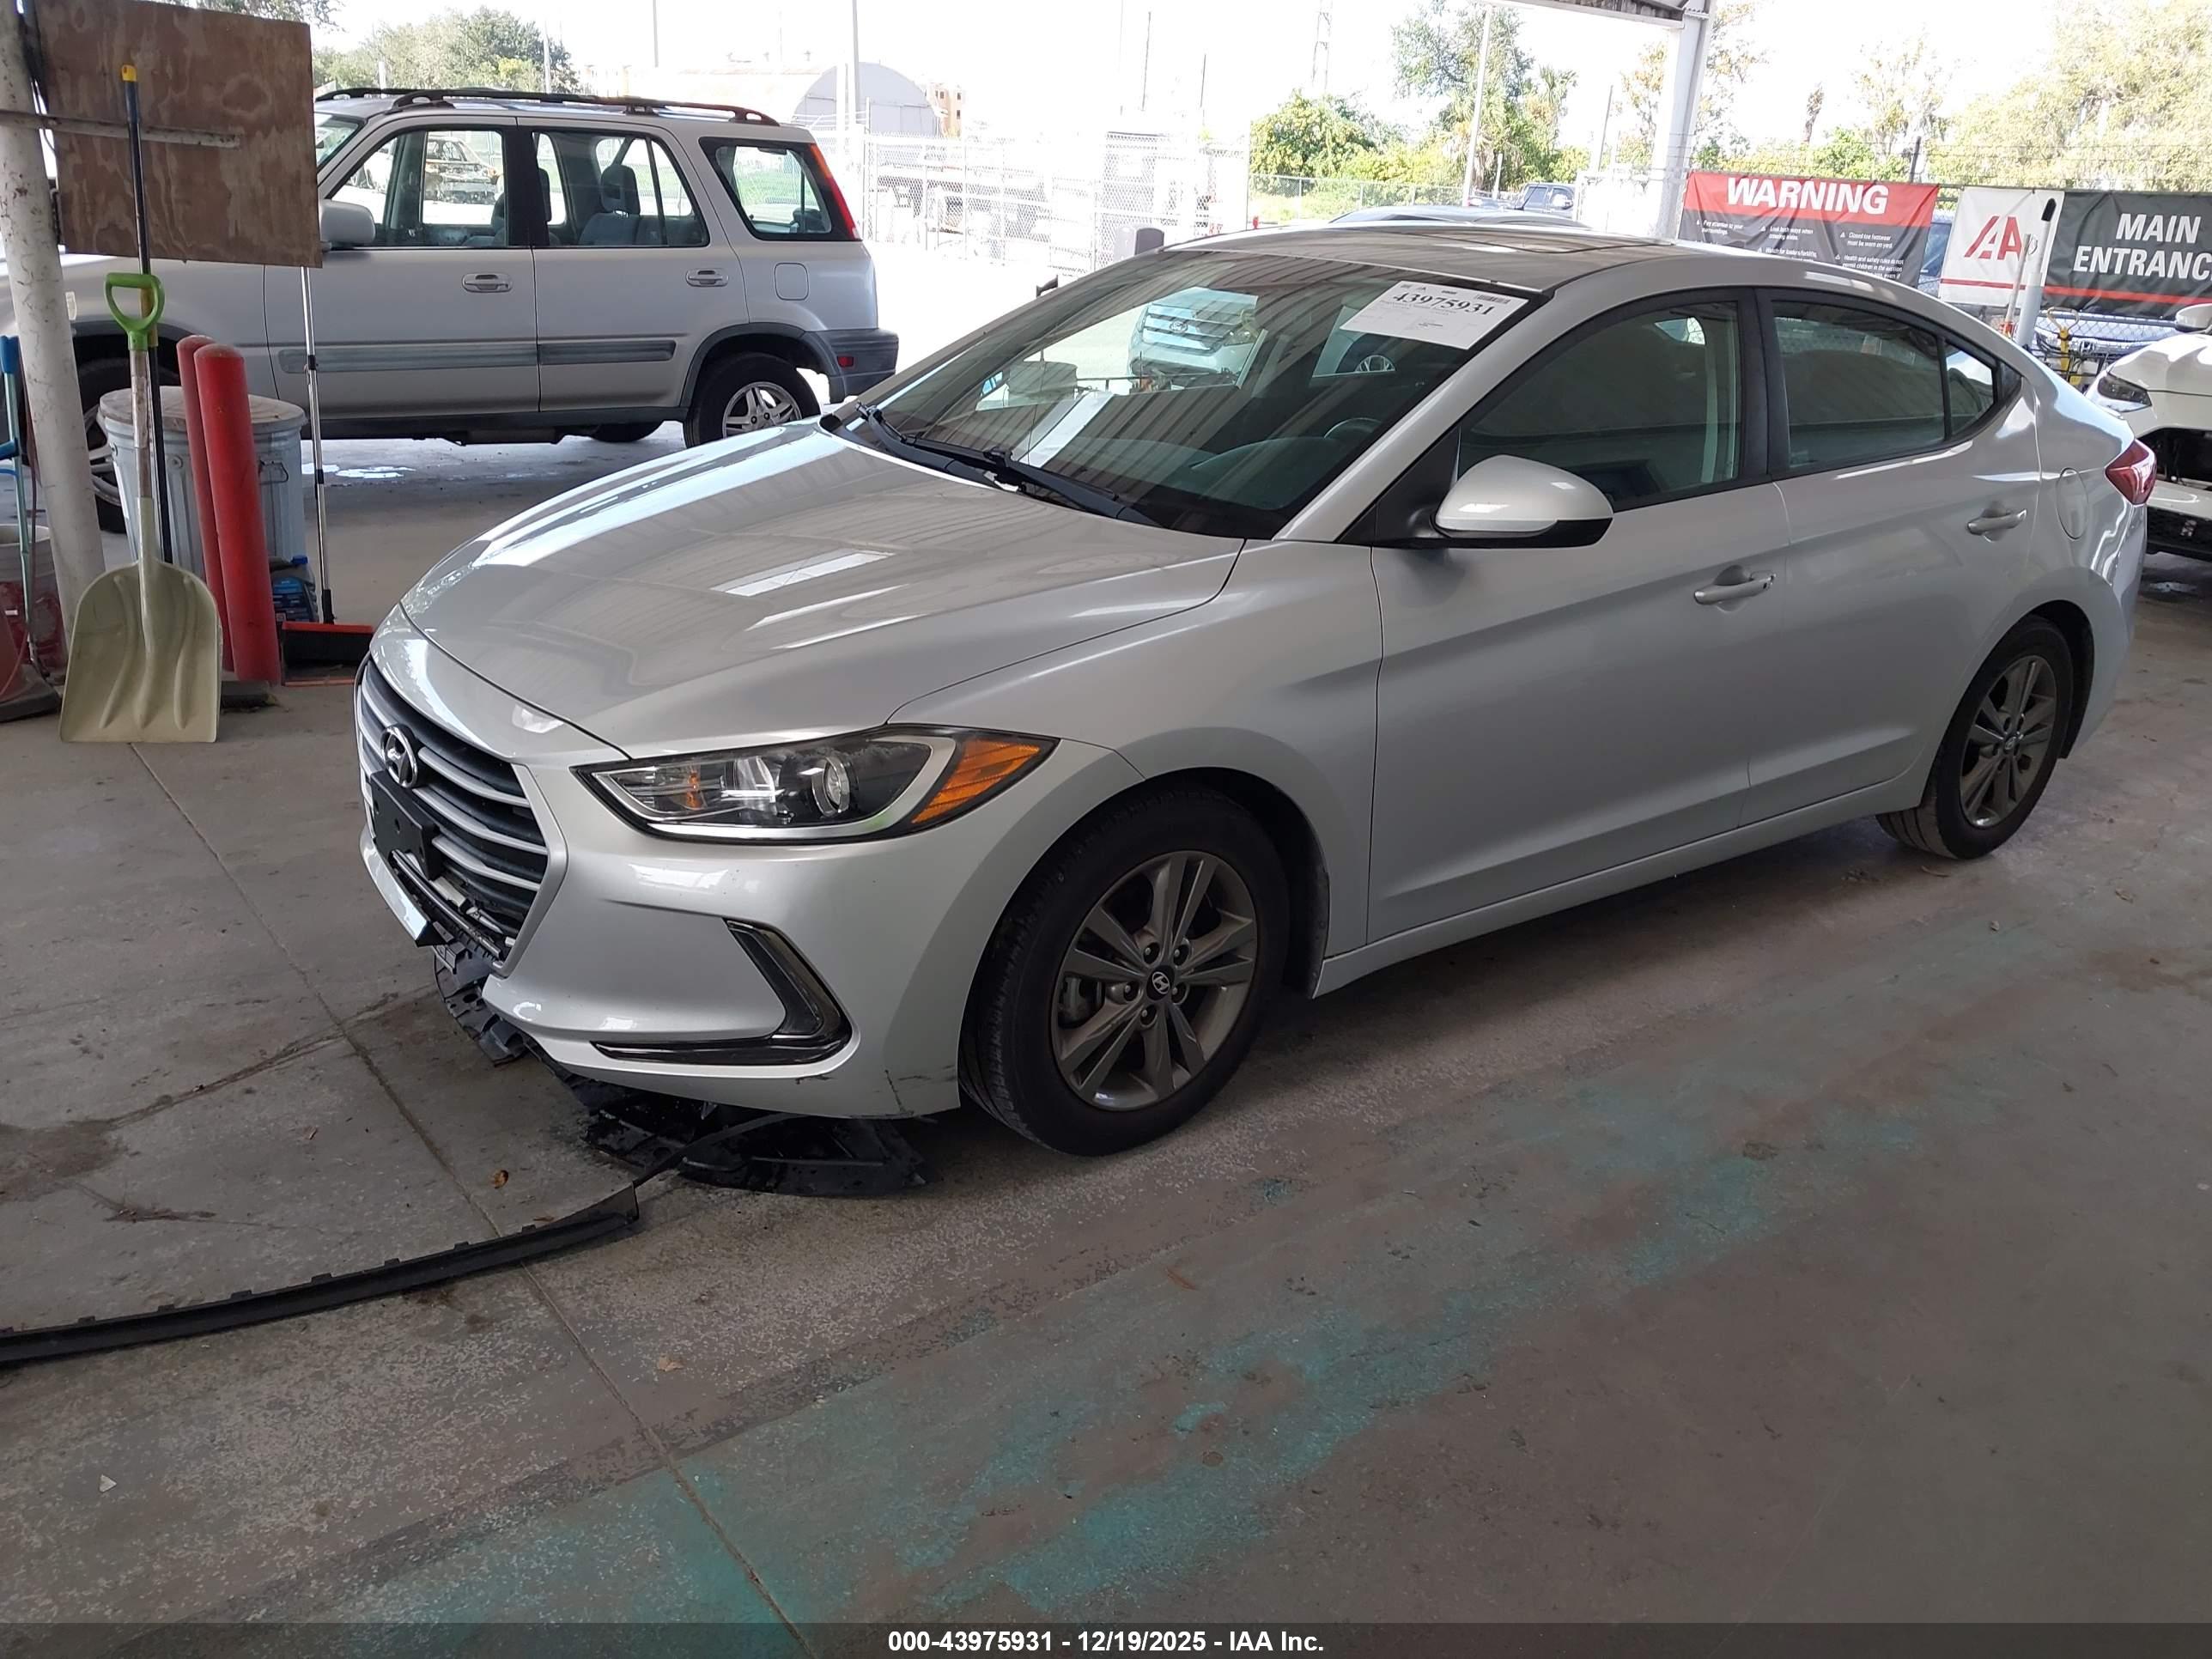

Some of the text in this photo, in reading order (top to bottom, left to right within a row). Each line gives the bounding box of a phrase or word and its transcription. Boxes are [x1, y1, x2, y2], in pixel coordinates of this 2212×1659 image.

[1728, 177, 1889, 215] WARNING
[2115, 213, 2202, 244] MAIN
[2073, 246, 2212, 281] ENTRANC
[1393, 293, 1495, 314] 43975931
